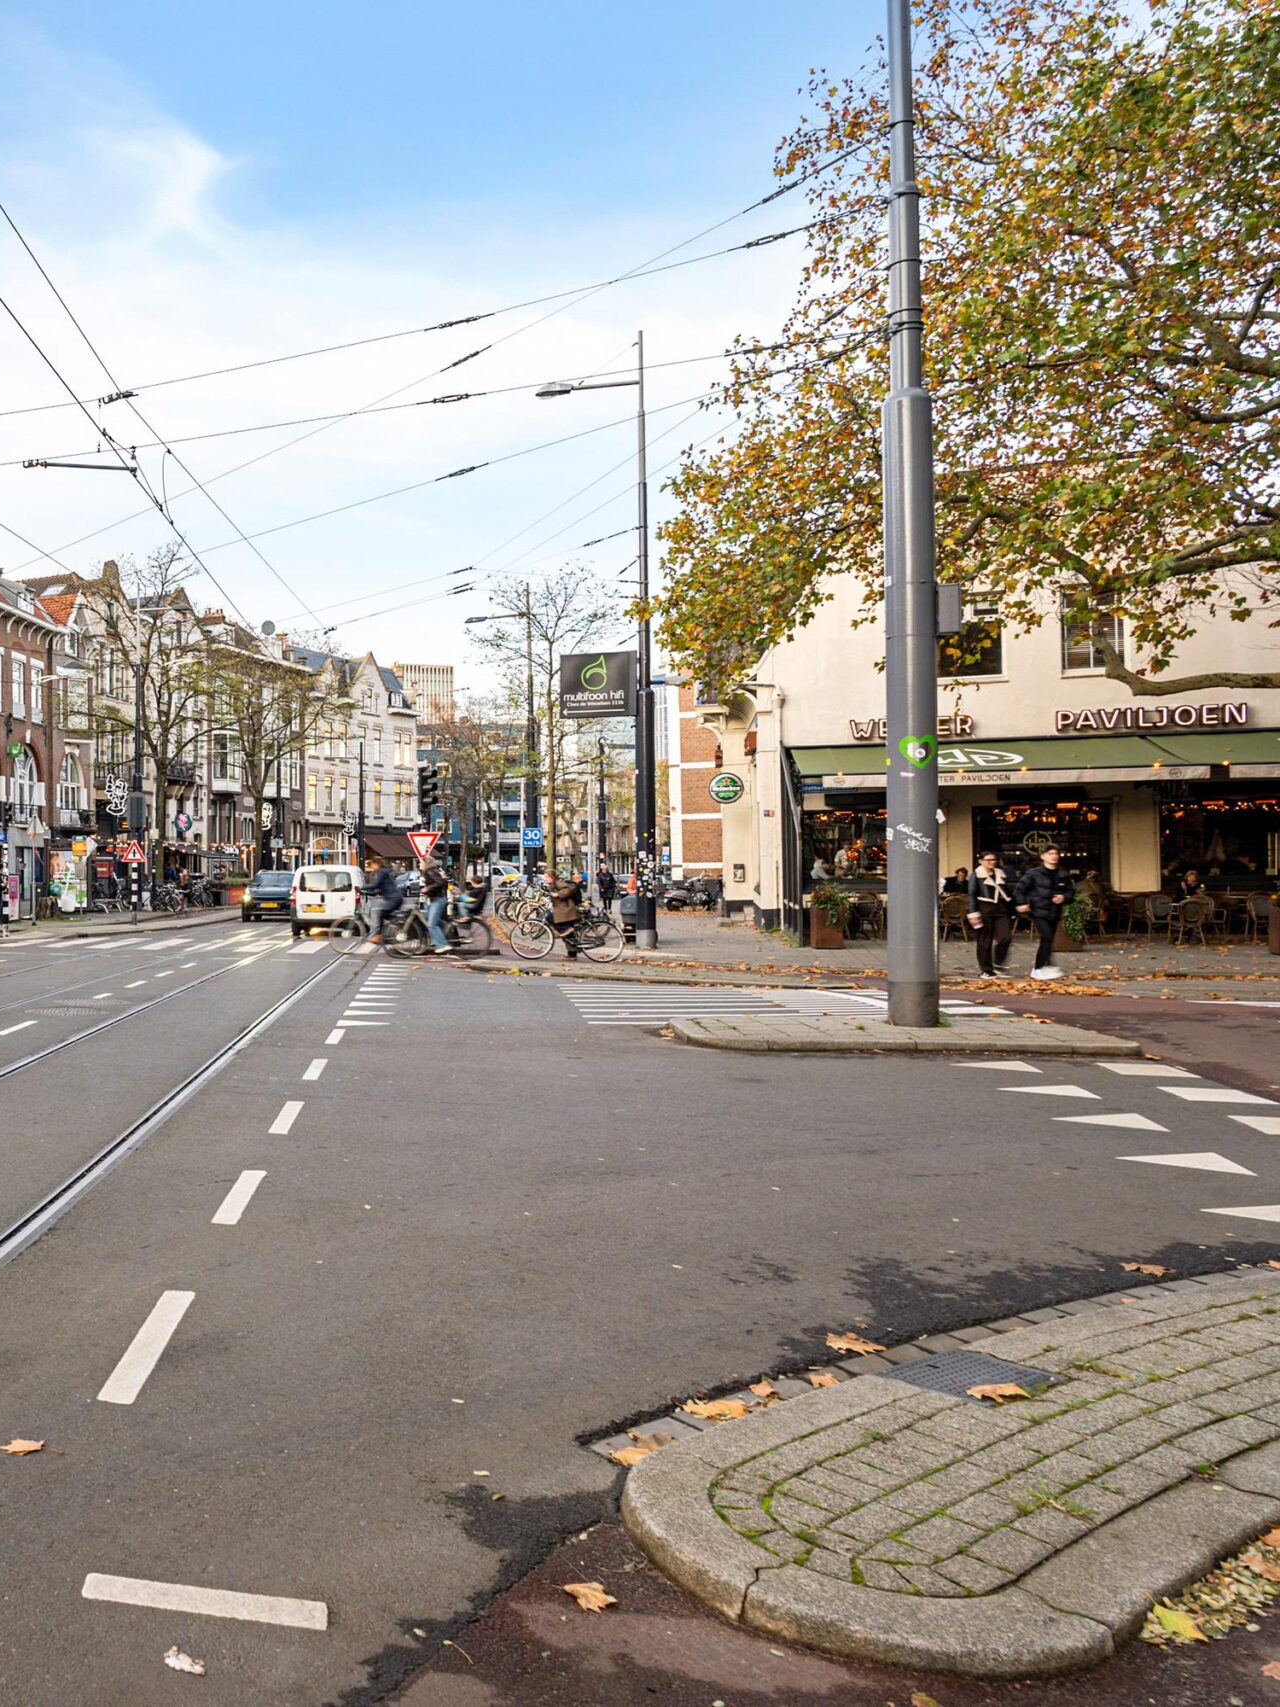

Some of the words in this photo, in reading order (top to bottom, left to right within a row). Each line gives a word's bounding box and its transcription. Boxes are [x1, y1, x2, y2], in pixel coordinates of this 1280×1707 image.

[563, 691, 608, 701] multifoon
[610, 689, 625, 700] hifi
[849, 715, 974, 740] WEER
[1056, 703, 1248, 732] PAVILJOEN
[961, 774, 1011, 782] PAVILJOEN
[524, 830, 540, 840] 30
